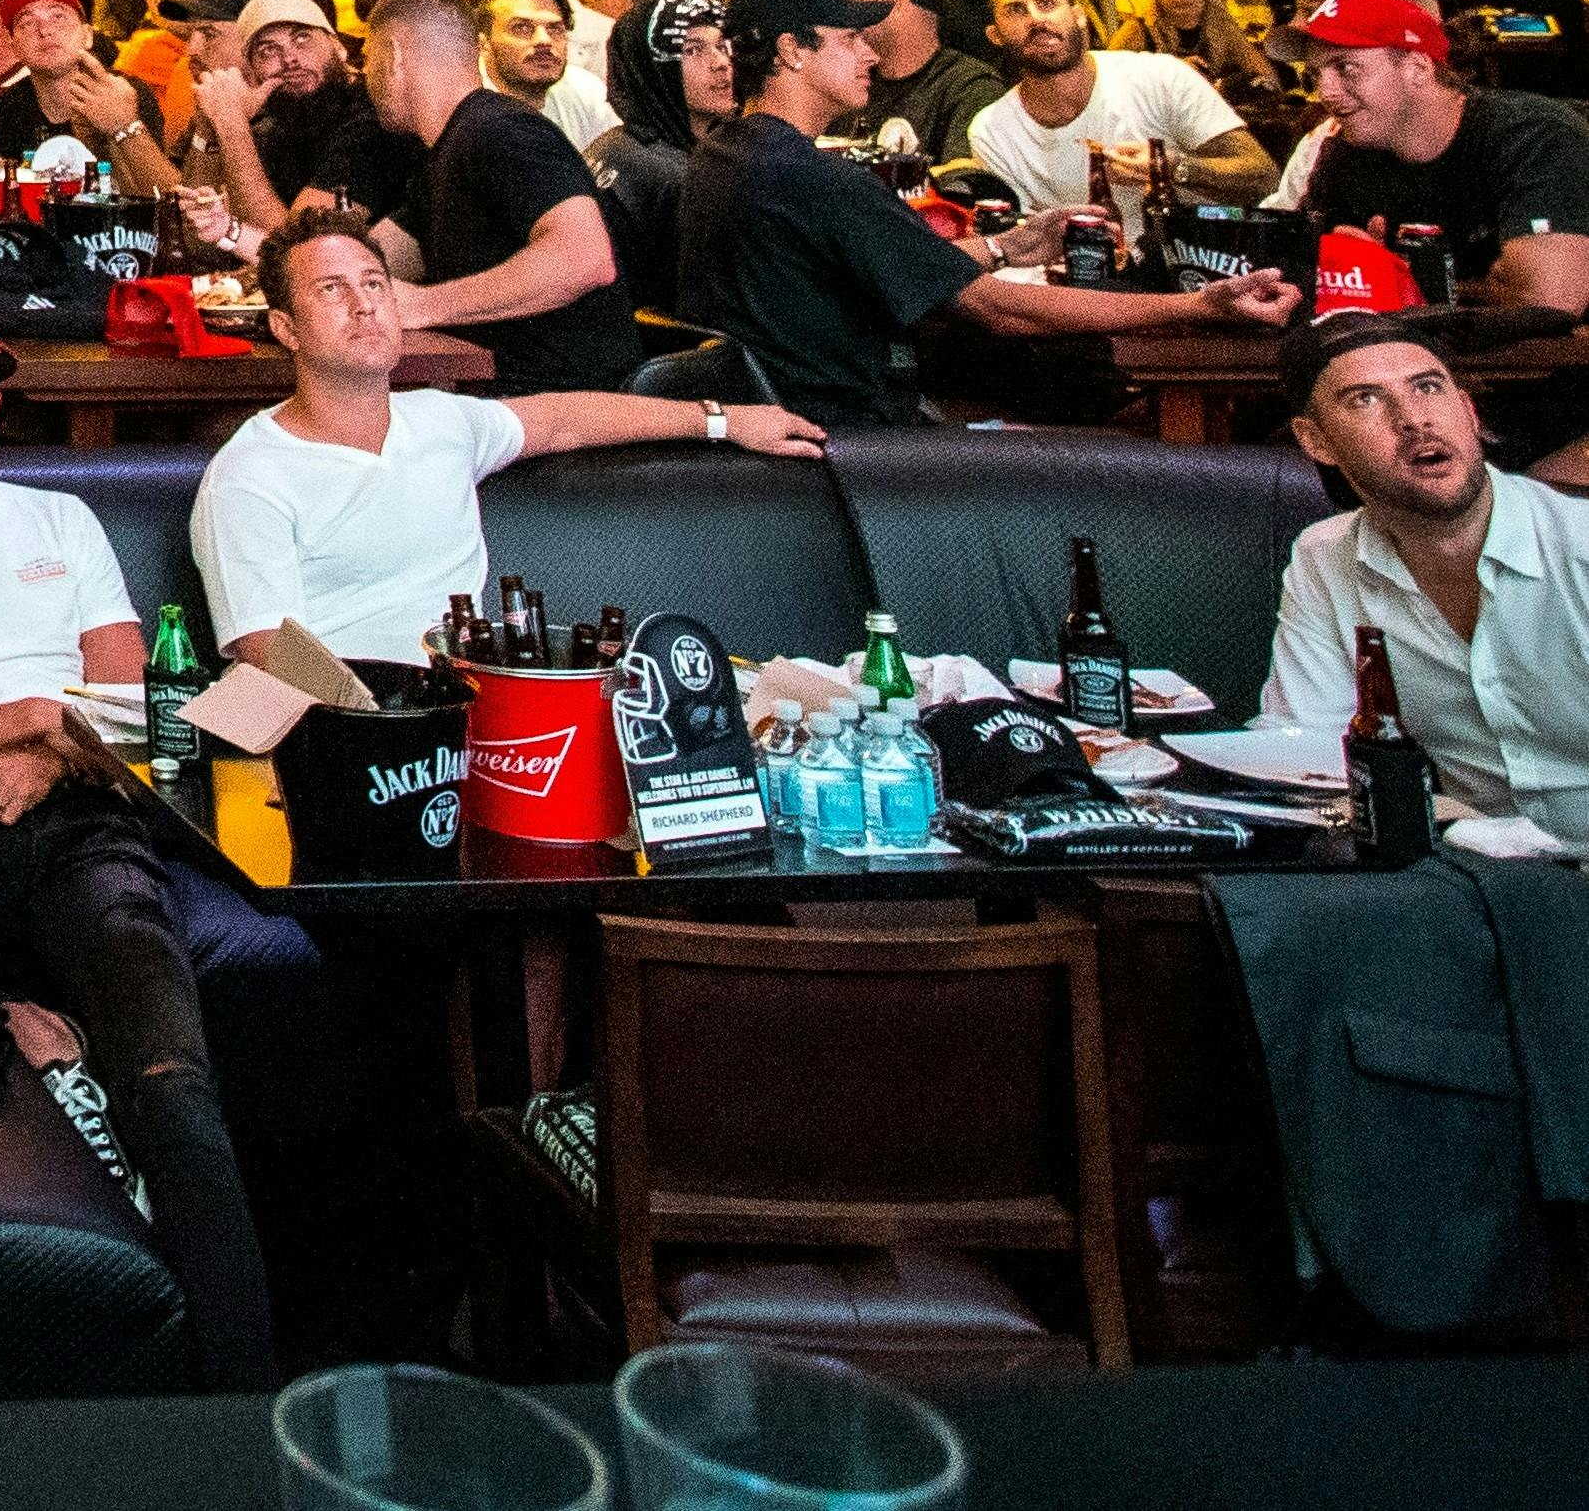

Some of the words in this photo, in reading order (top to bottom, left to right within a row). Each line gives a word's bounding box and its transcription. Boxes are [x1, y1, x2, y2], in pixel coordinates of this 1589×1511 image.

[368, 757, 434, 805] JACK
[651, 812, 699, 828] RICHARD
[699, 805, 754, 823] SHEPHERD
